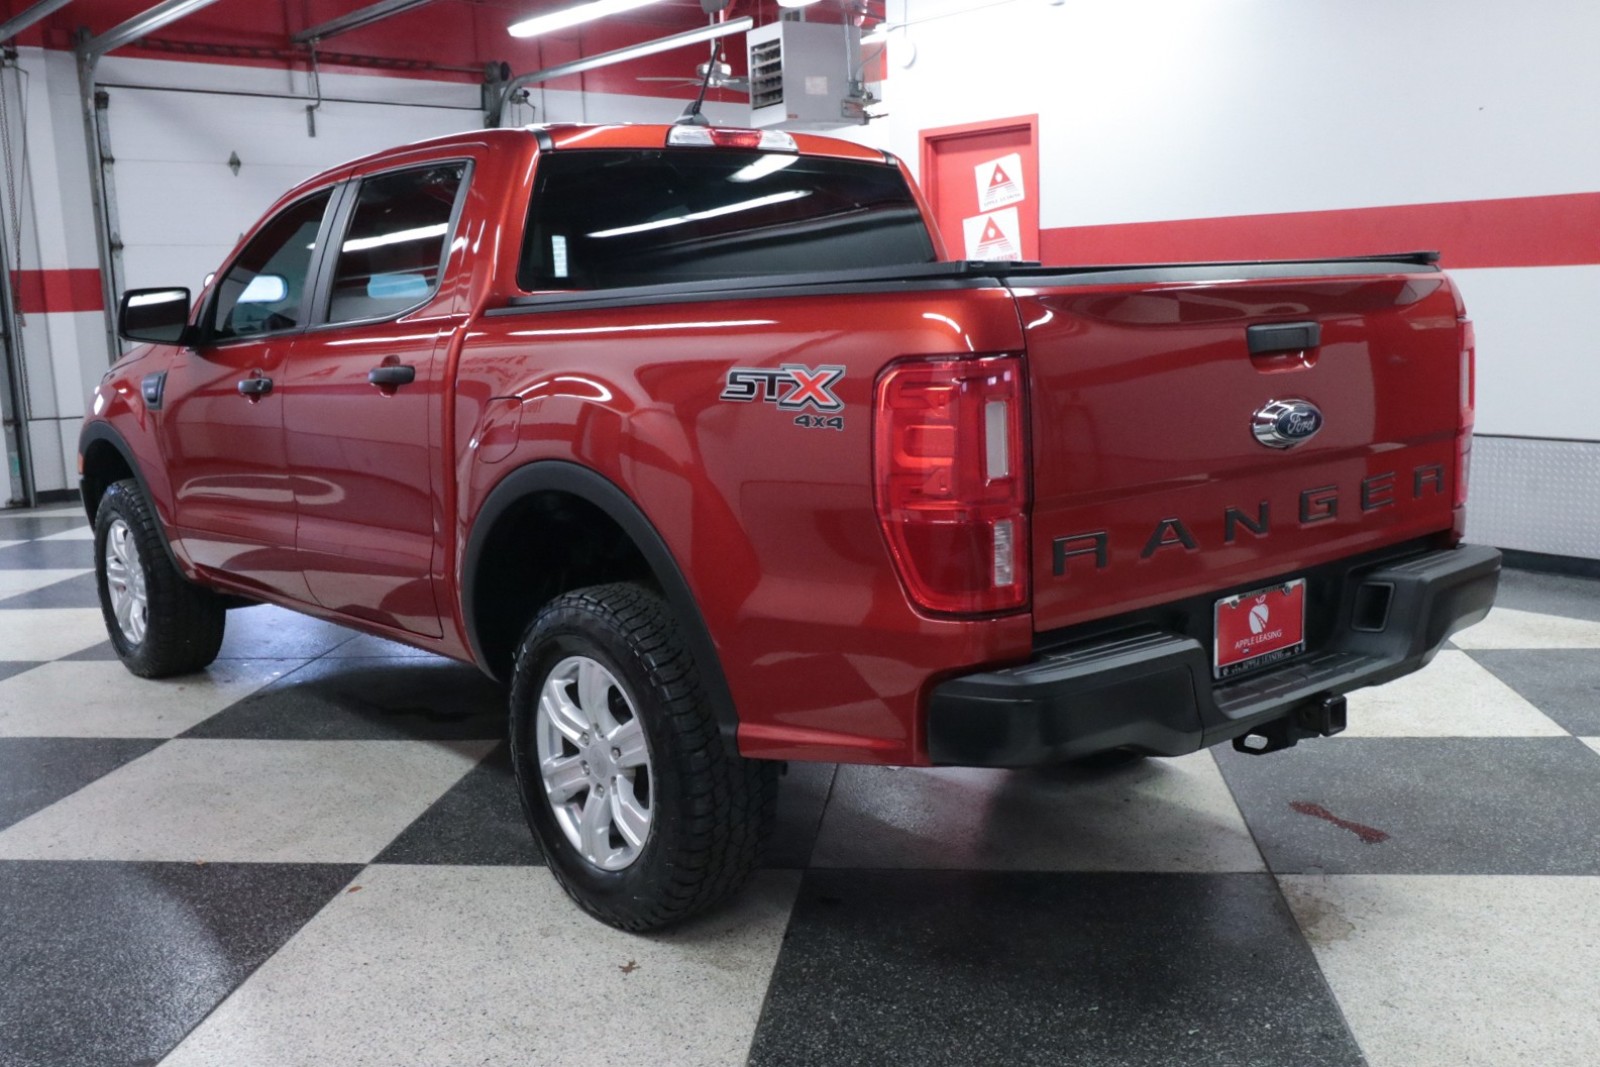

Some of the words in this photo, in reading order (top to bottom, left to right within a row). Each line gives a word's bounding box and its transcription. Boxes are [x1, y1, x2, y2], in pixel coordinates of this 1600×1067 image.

[720, 363, 846, 413] STX
[1287, 411, 1315, 434] Ford
[1053, 463, 1443, 576] RANGER
[1235, 636, 1255, 649] APPLE
[1256, 629, 1283, 643] LEASING
